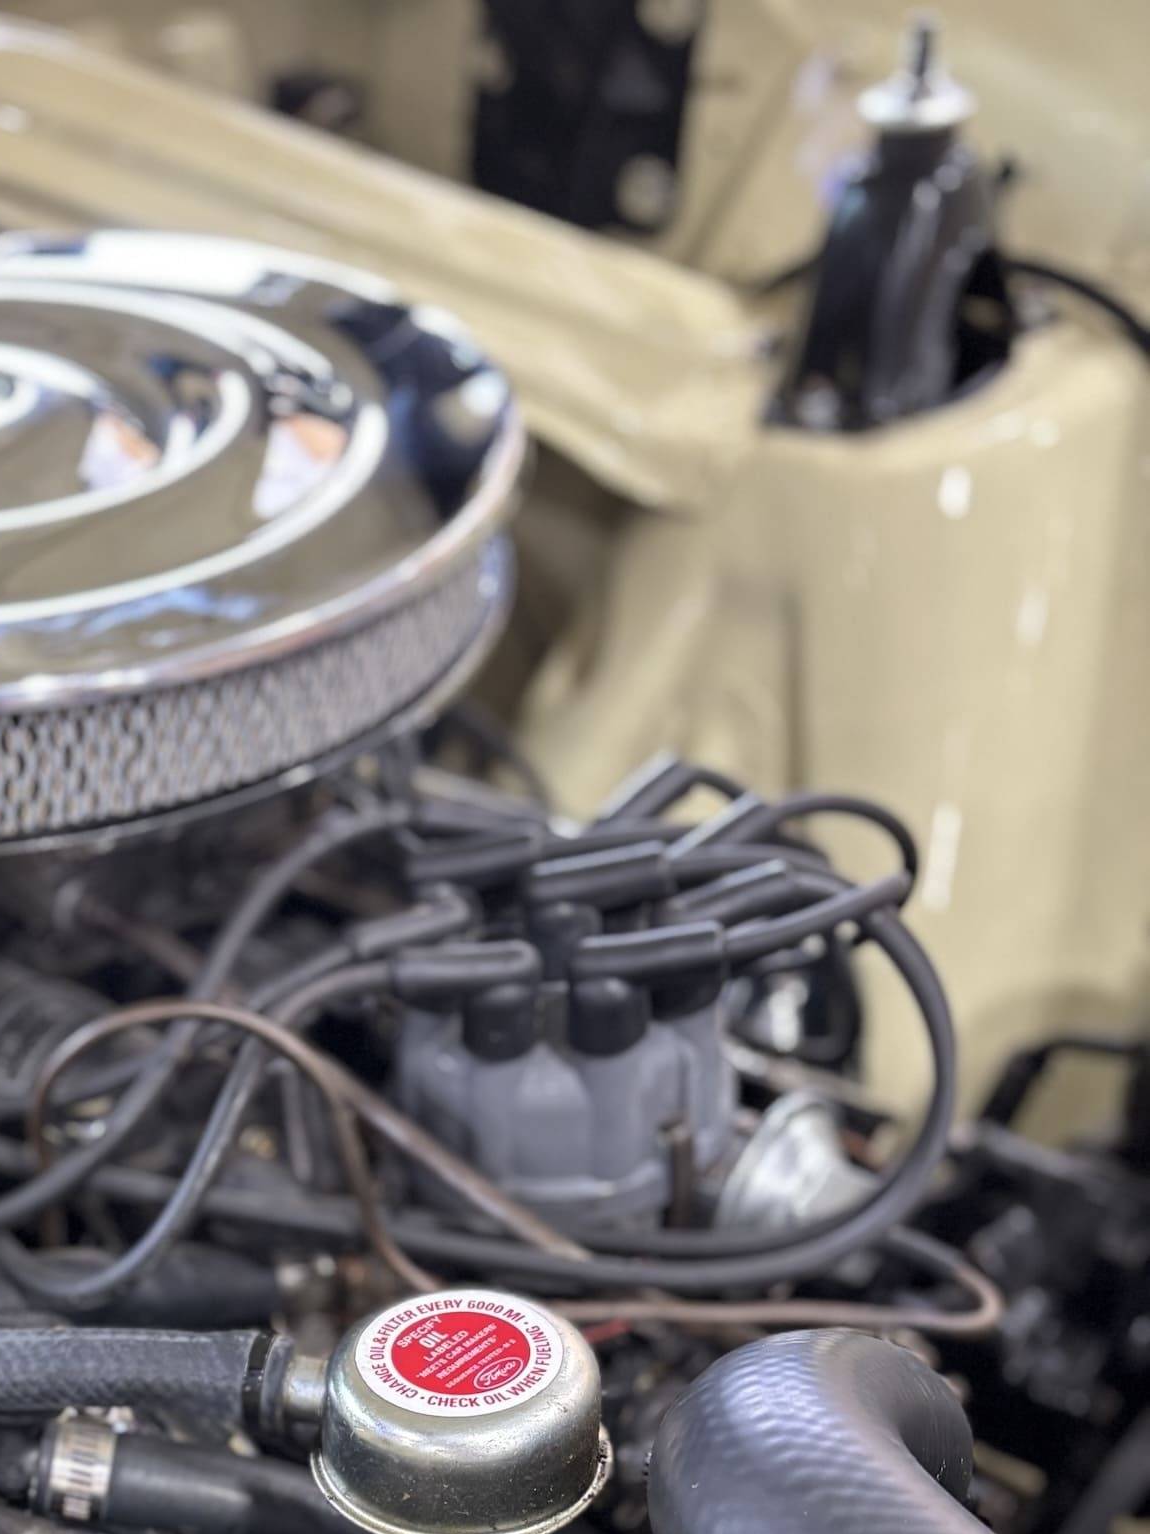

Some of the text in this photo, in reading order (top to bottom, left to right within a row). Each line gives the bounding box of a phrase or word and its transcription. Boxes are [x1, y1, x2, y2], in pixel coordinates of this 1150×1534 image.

[416, 1299, 463, 1315] EVERY
[467, 1299, 504, 1314] 6000
[502, 1308, 525, 1323] MI
[396, 1315, 443, 1348] SPECIFY
[418, 1329, 449, 1349] OIL
[423, 1330, 469, 1362] LABELED
[525, 1325, 552, 1367] FUELING
[372, 1362, 419, 1399] CHANGE
[506, 1367, 547, 1397] WHEN
[427, 1395, 480, 1408] CHECK
[483, 1391, 511, 1406] OIL
